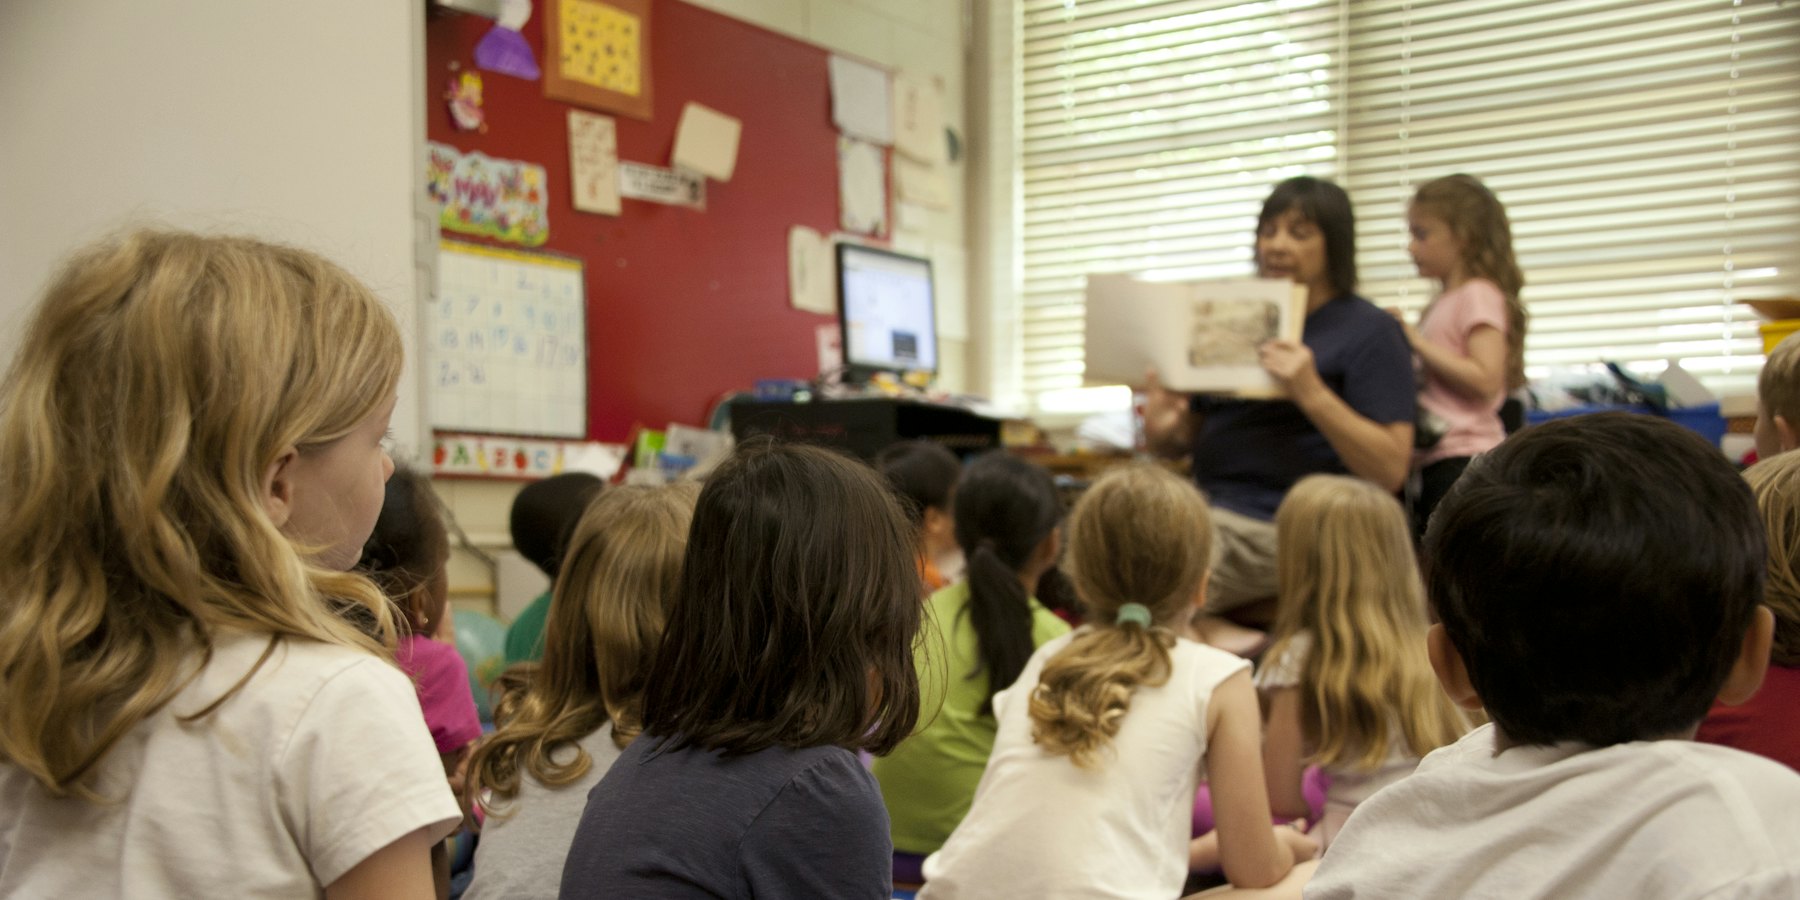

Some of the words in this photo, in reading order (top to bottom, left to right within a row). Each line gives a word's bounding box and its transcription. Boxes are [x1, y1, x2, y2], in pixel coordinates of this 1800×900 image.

[536, 336, 559, 368] 17
[453, 444, 469, 466] A
[534, 450, 548, 468] C
